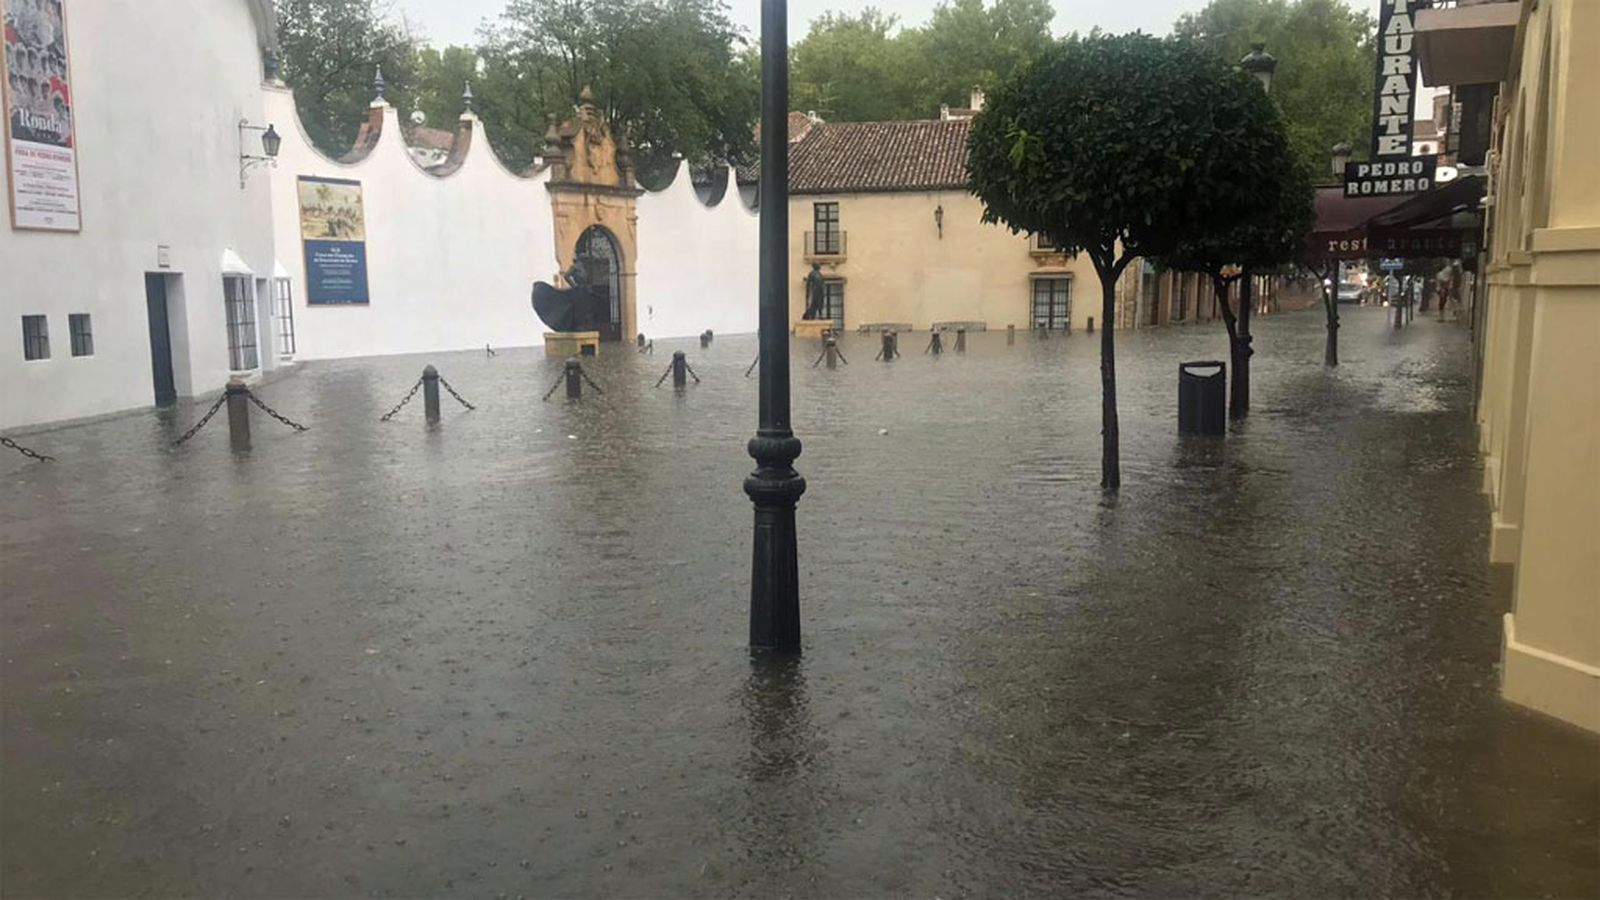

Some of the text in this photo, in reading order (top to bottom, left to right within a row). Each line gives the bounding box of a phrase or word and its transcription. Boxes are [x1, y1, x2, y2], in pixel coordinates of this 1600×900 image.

[19, 107, 62, 133] Ronda
[1357, 161, 1424, 178] PEDRO
[1347, 178, 1430, 195] ROMERO
